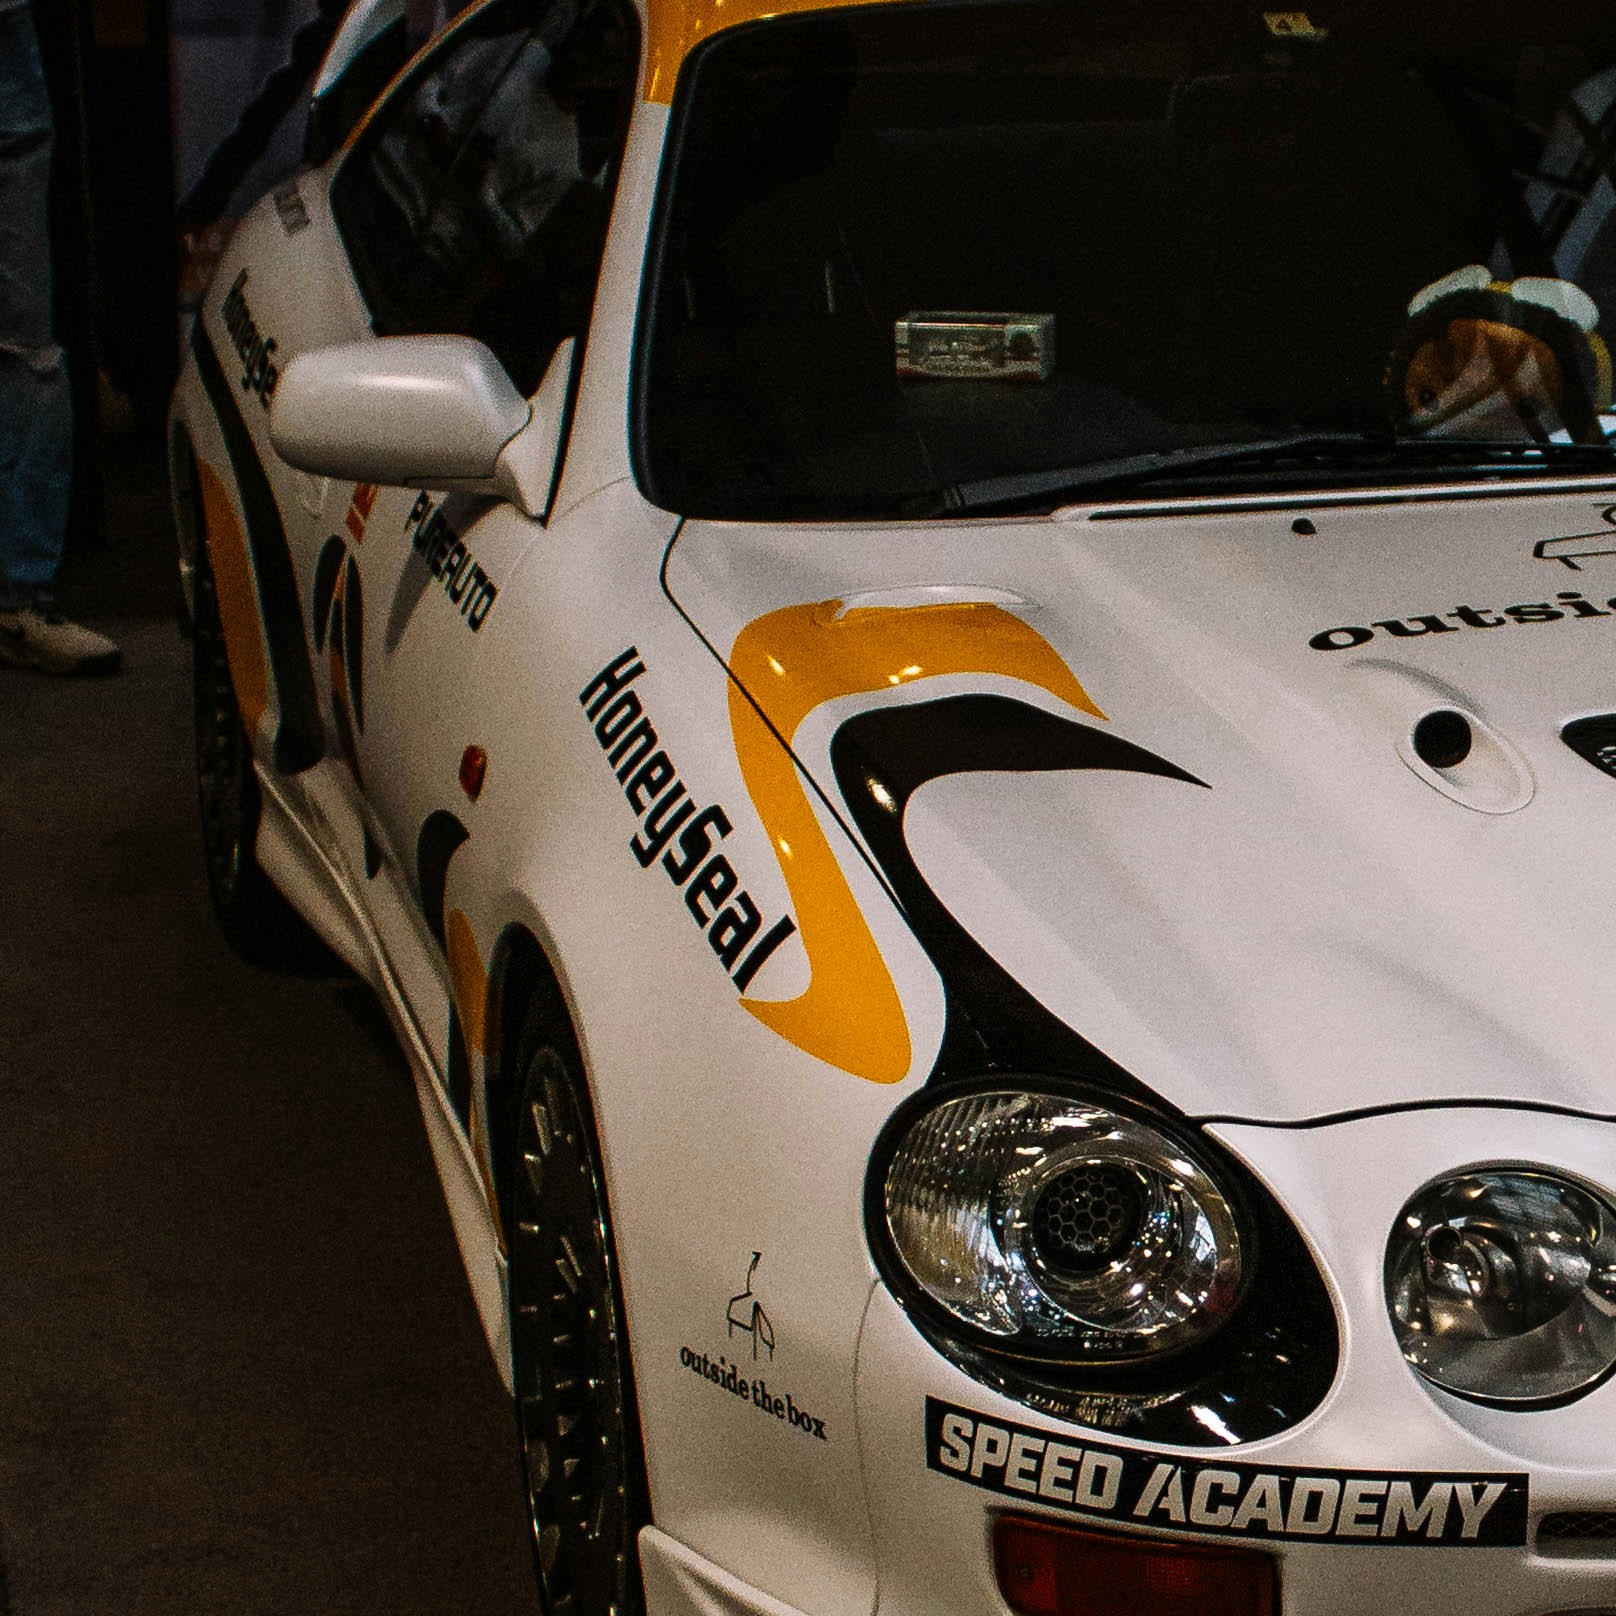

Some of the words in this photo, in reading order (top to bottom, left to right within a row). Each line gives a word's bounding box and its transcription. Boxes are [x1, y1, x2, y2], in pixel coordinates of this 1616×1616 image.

[404, 488, 497, 632] PUREAUTO
[579, 646, 797, 995] HoneySeal
[680, 1346, 749, 1400] outside
[751, 1380, 786, 1420] the
[785, 1394, 828, 1442] box
[939, 1411, 1124, 1513] SPEED
[1133, 1461, 1507, 1541] ACADEMY
